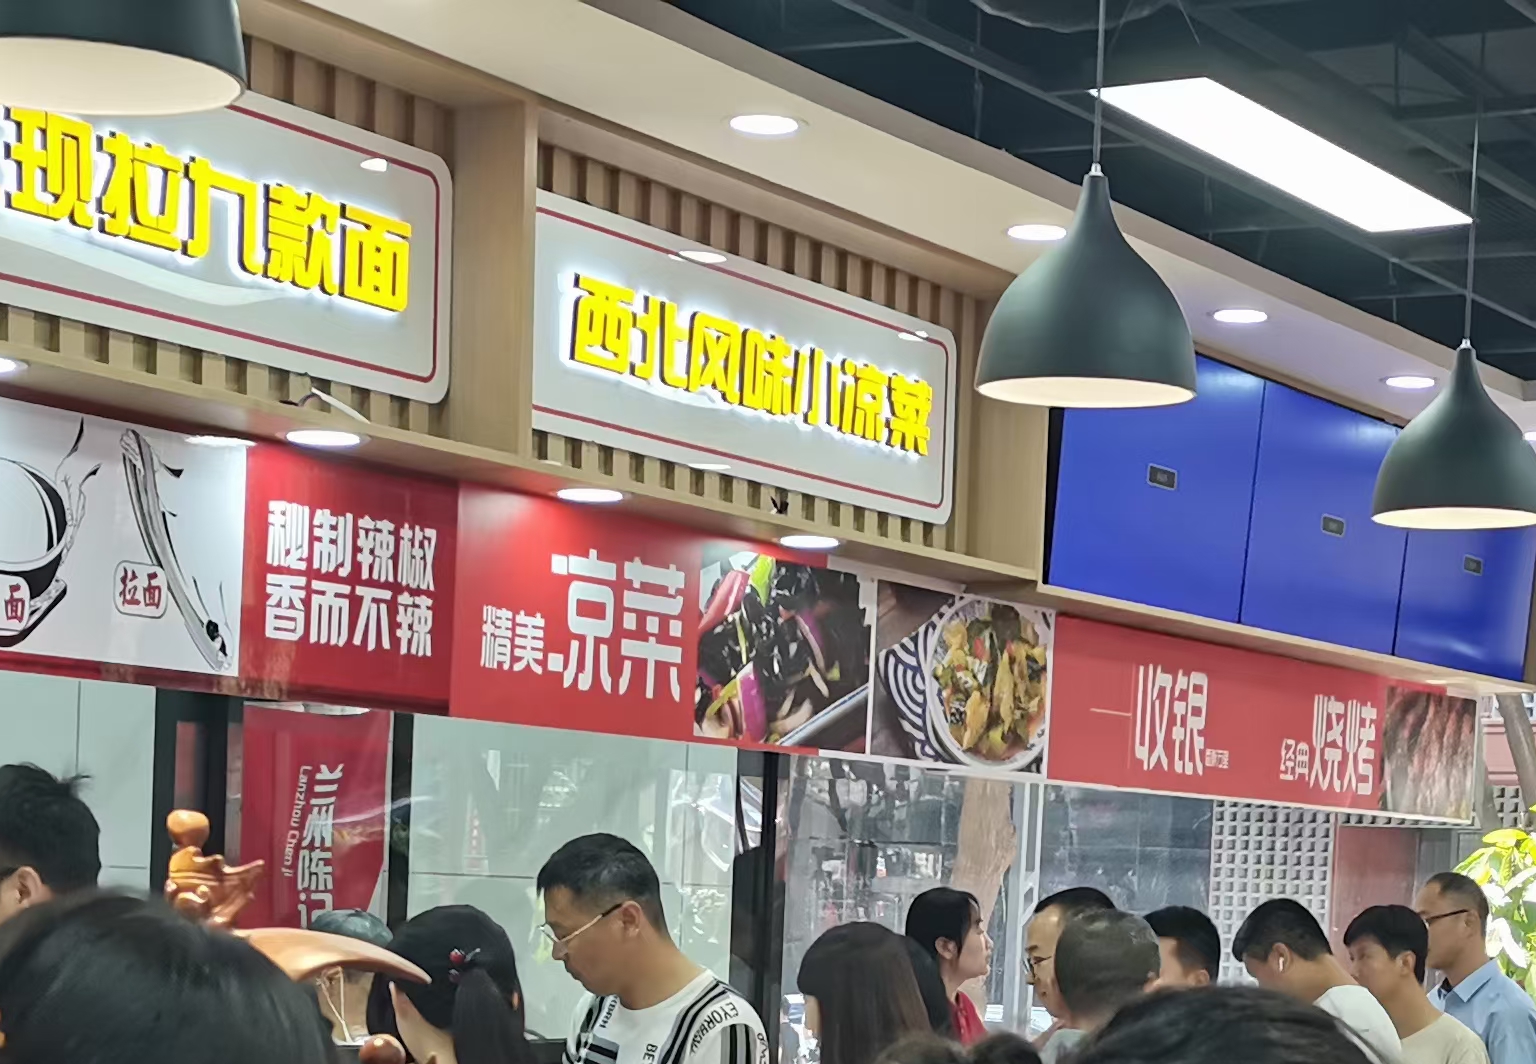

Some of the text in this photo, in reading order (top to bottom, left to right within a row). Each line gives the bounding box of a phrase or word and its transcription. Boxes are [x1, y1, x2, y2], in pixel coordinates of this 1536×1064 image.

[570, 272, 932, 457] 西北风味小凉菜
[119, 568, 163, 610] 拉面
[266, 500, 437, 593] 秘制辣椒
[264, 573, 434, 658] 香而不辣
[1134, 664, 1208, 776] 收银
[290, 765, 313, 828] Lanzhou
